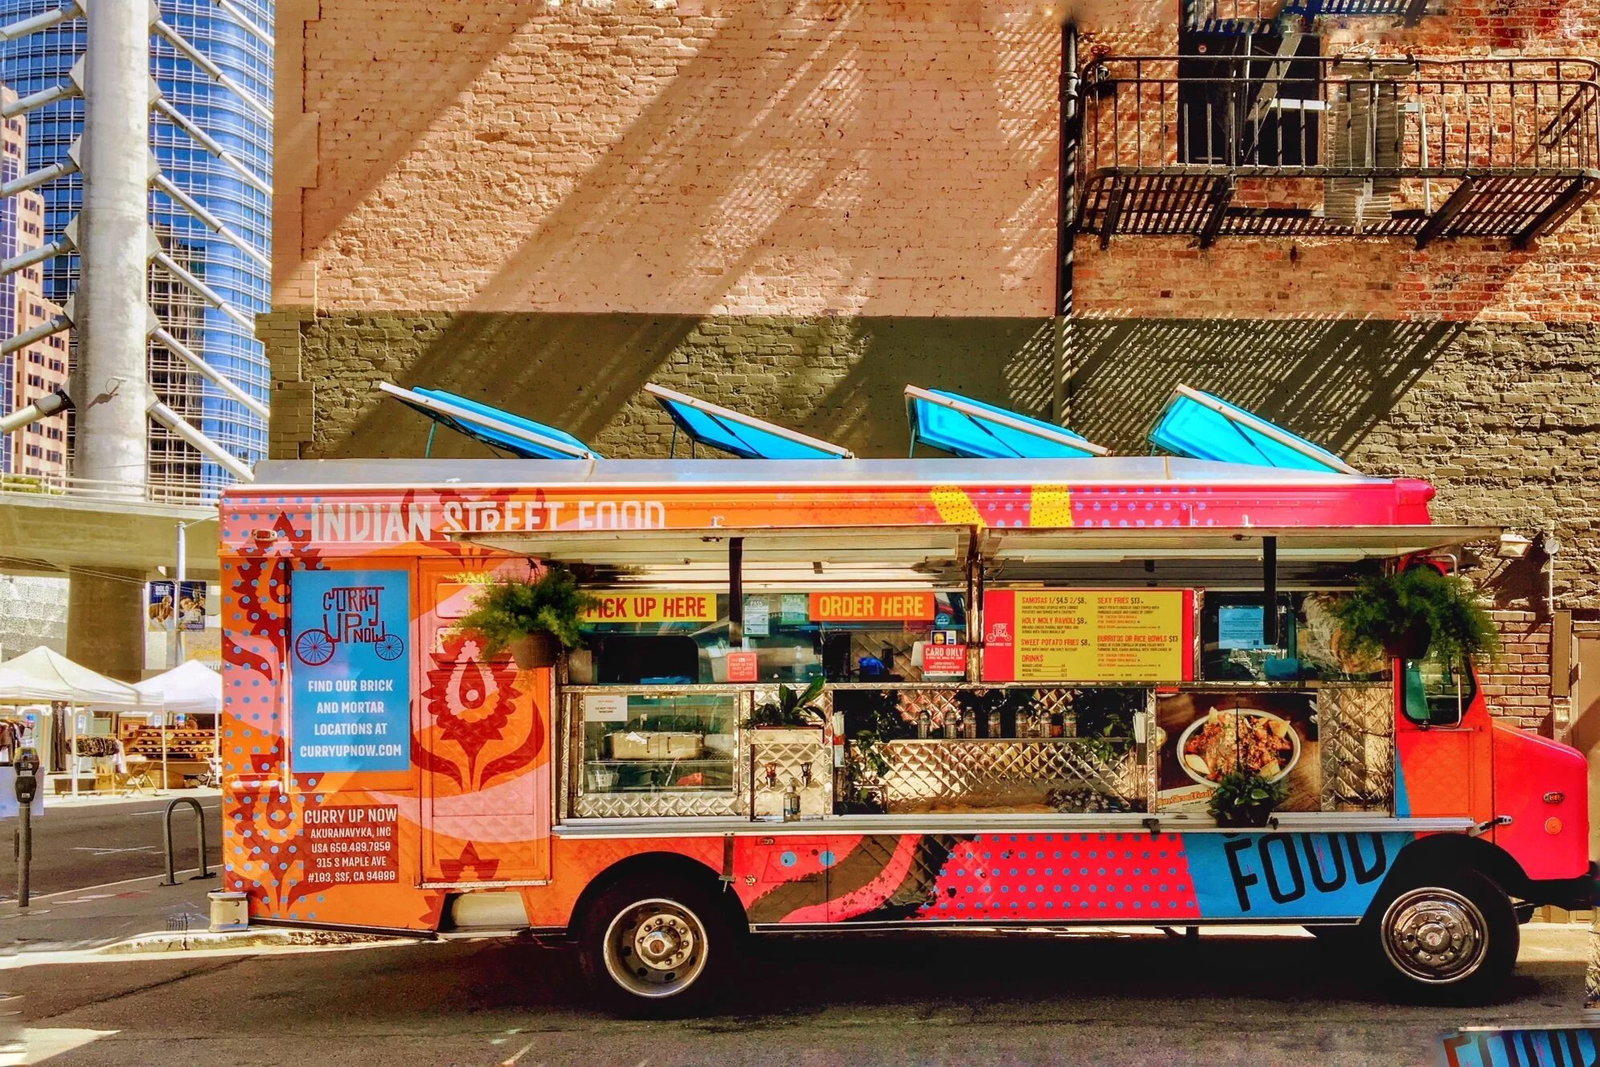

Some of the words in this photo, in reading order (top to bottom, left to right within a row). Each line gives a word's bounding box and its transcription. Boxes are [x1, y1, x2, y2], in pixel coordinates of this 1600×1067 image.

[311, 502, 431, 541] INDIAN
[443, 501, 565, 537] STREET
[578, 501, 665, 530] FOOD
[323, 586, 384, 626] CURRY
[634, 597, 657, 618] UP
[663, 596, 707, 618] HERE
[820, 595, 875, 617] ORDER
[881, 595, 925, 617] HERE
[1022, 617, 1036, 625] HOLY
[1037, 617, 1054, 625] MOLY
[323, 613, 362, 643] UP
[353, 621, 386, 643] NOW
[1021, 638, 1040, 646] SWEET
[1041, 638, 1063, 646] POTATO
[1063, 638, 1080, 646] FRIES
[1097, 635, 1123, 643] BURRITOS
[1133, 635, 1146, 643] RICE
[1147, 635, 1167, 643] BOWLS
[925, 647, 944, 656] CARD
[946, 647, 964, 656] ONLY
[1021, 654, 1044, 662] DRINKS
[308, 680, 333, 693] FIND
[335, 679, 357, 692] OUR
[360, 679, 394, 692] BRICK
[316, 702, 339, 714] AND
[341, 701, 384, 714] MORTAR
[314, 722, 373, 736] LOCATIONS
[374, 722, 388, 735] AT
[300, 744, 402, 757] CURRYUPNOW.COM
[304, 809, 345, 824] CURRY
[348, 808, 364, 823] UP
[368, 808, 397, 822] NOW
[310, 827, 375, 838] AKURANAVYKA,
[376, 826, 391, 837] INC
[311, 843, 328, 853] USA
[316, 857, 332, 868] 315
[334, 857, 340, 868] S
[342, 856, 369, 867] MAPLE
[371, 856, 387, 866] AVE
[335, 871, 352, 882] SSF,
[353, 871, 365, 881] CA
